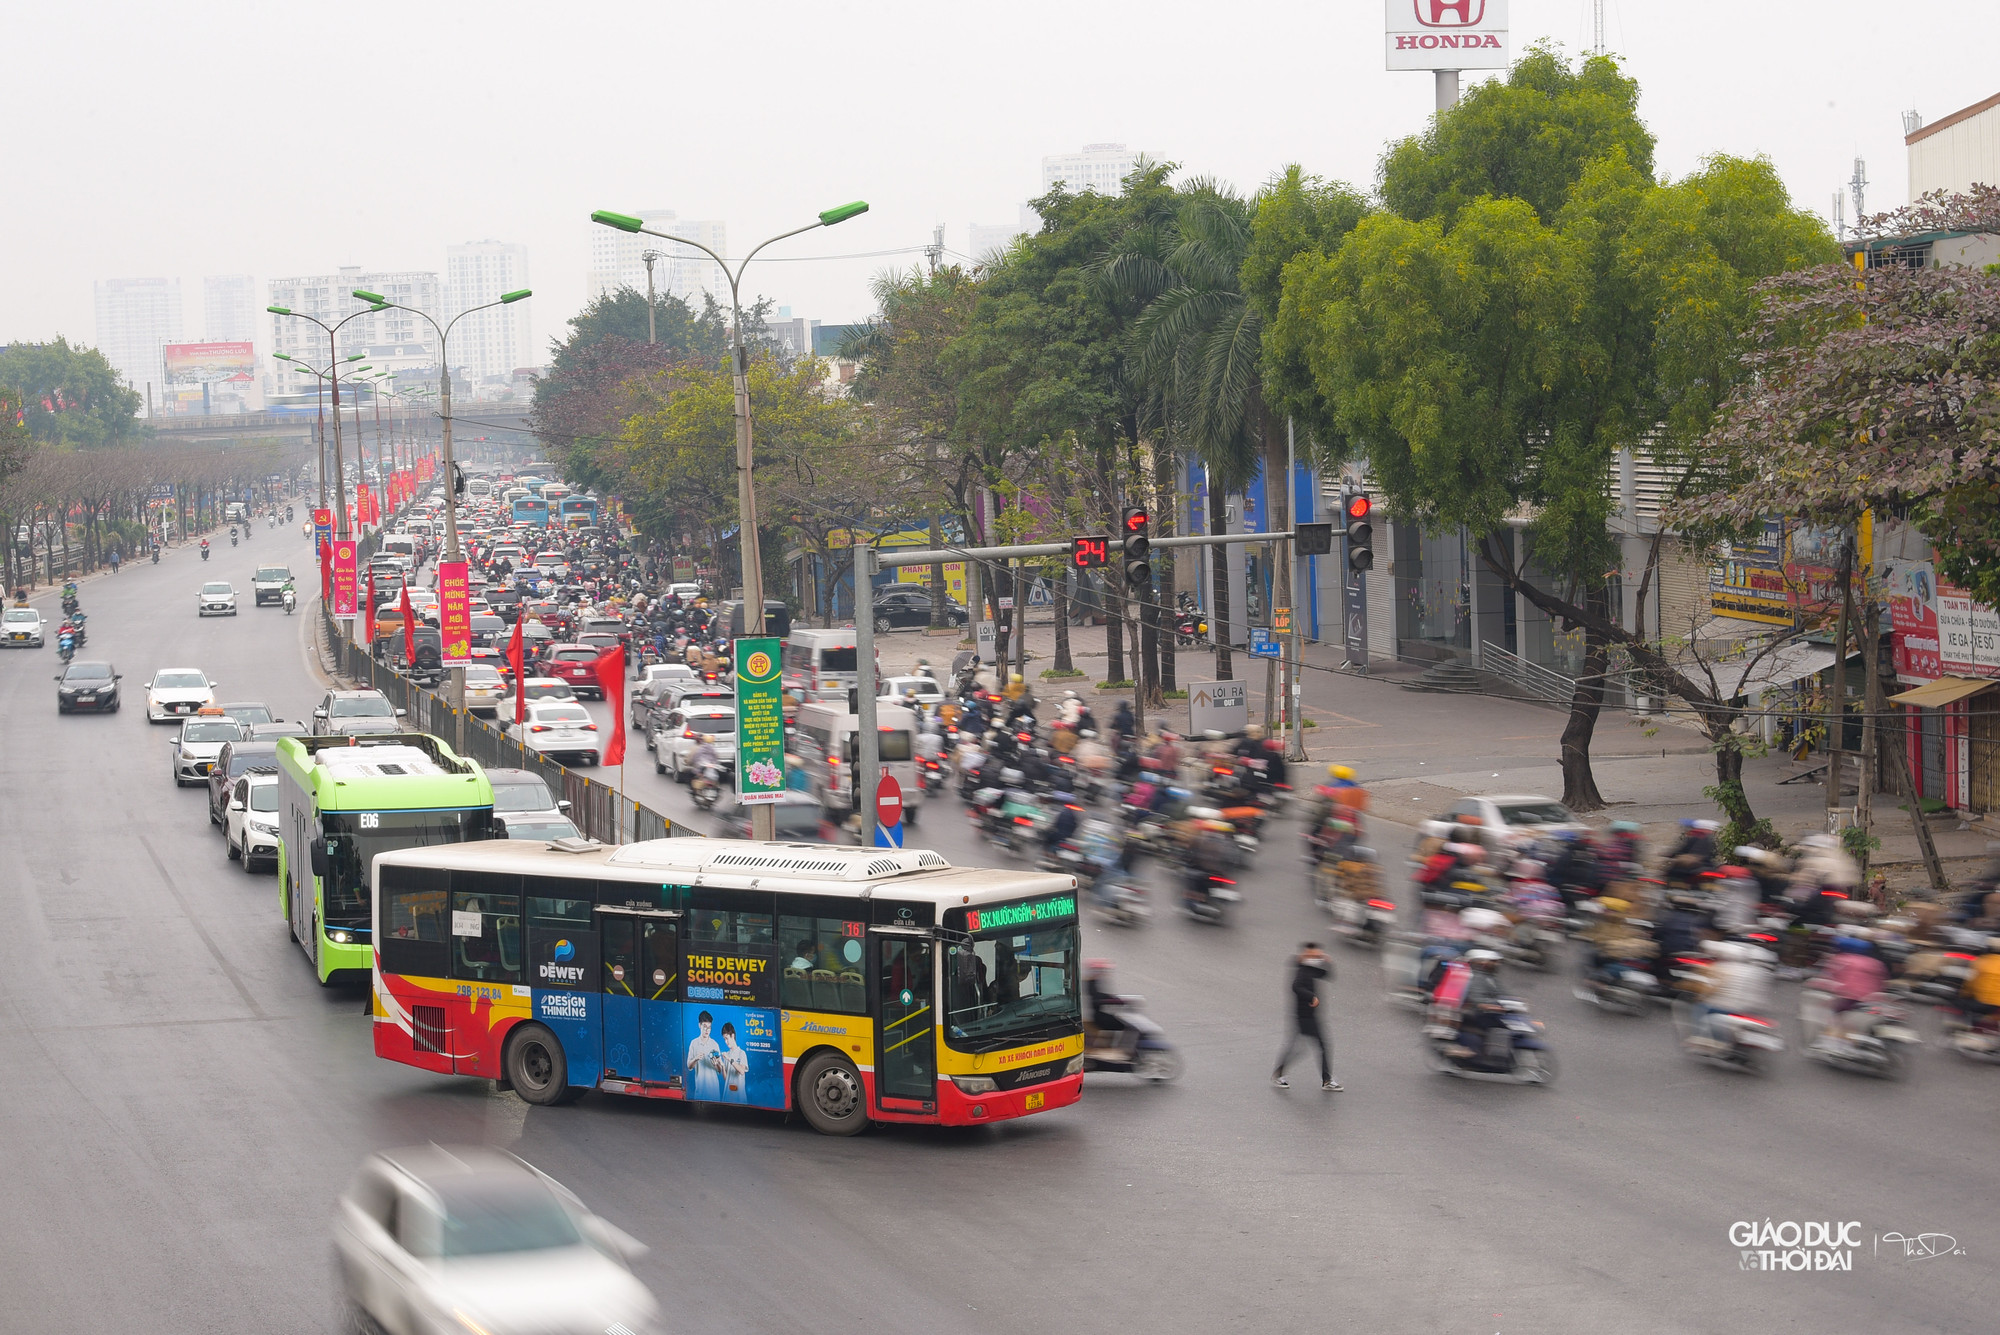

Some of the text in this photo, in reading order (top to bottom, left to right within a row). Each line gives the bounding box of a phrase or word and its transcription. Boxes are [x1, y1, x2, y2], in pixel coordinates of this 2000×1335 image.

[1395, 34, 1502, 50] HONDA
[1075, 539, 1105, 566] 24
[444, 577, 465, 587] CHÚC
[444, 589, 466, 599] MỪNG
[447, 602, 464, 611] NĂM
[1275, 613, 1290, 628] LỐP
[1940, 612, 1951, 624] SỬA
[1951, 614, 1965, 626] CHỮA
[1948, 632, 1957, 646] XE
[1958, 633, 1969, 647] GA
[1973, 634, 1983, 648] XE
[1984, 633, 1994, 650] SỐ
[1212, 684, 1244, 698] LỐI RA
[1223, 698, 1235, 706] OUT
[360, 813, 379, 829] E06
[966, 910, 980, 930] 16
[847, 923, 860, 936] 16
[687, 954, 767, 973] THE DEWEY
[539, 964, 585, 980] DEWEY
[687, 969, 752, 986] SCHOOLS
[456, 985, 502, 1000] 29B-123.84
[745, 1018, 760, 1027] LỚP
[800, 1021, 847, 1035] HANOIBUS
[750, 1027, 764, 1036] LỚP
[765, 1029, 773, 1037] 12
[1014, 1068, 1051, 1083] HANOIBUS
